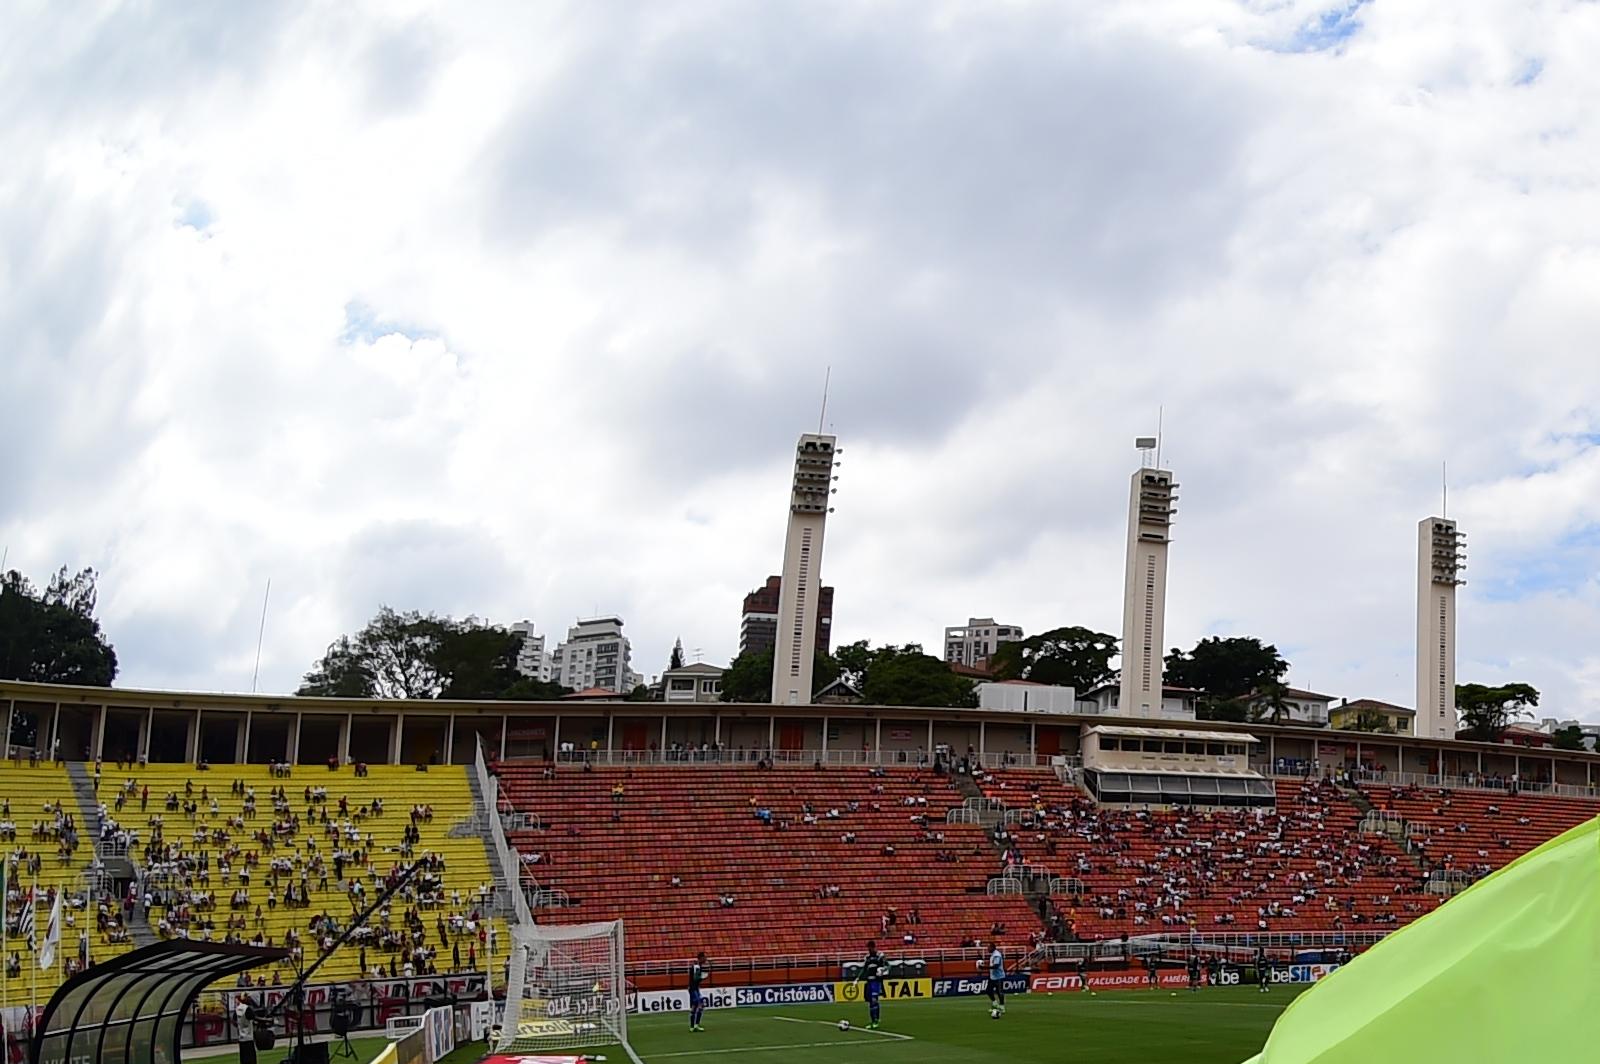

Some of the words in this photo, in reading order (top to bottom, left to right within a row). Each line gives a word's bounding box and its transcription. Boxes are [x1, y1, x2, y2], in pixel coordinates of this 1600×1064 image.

[641, 997, 682, 1013] Leite
[701, 993, 731, 1010] alac
[737, 990, 761, 1004] São
